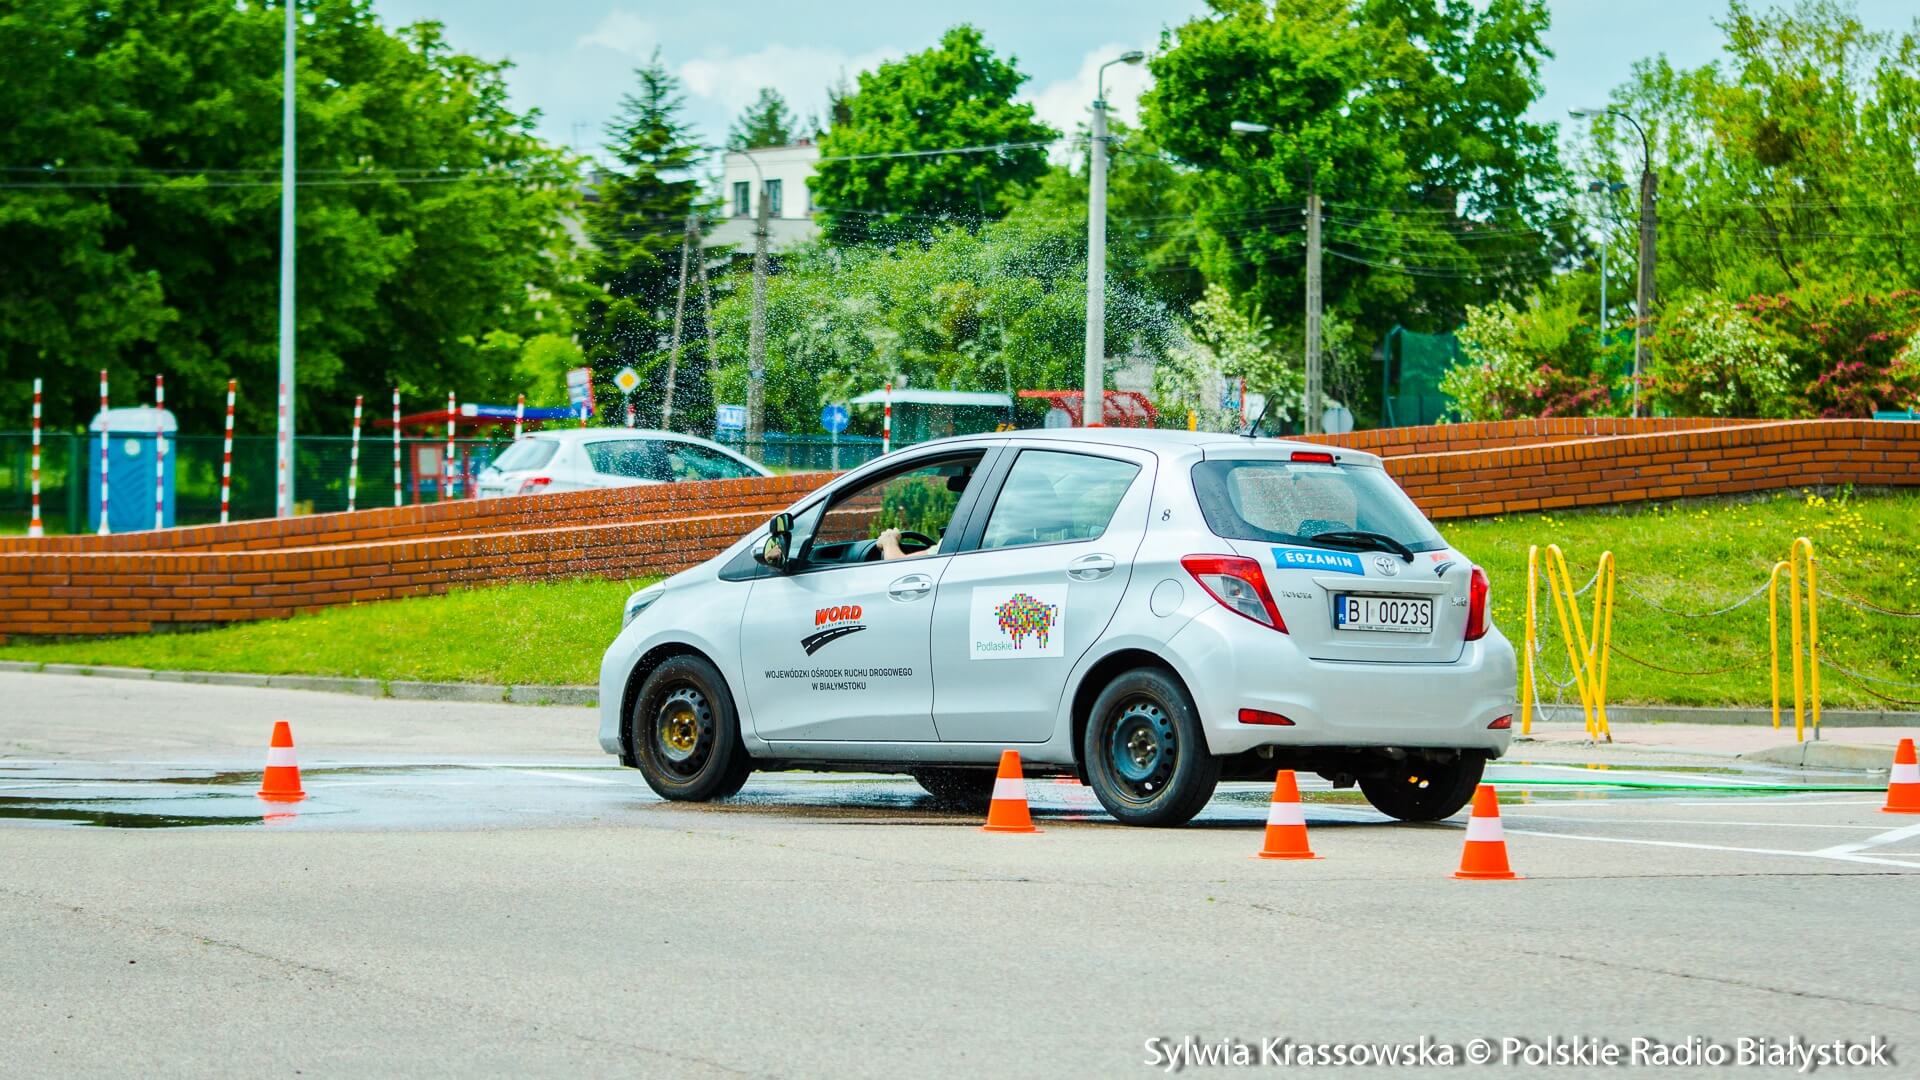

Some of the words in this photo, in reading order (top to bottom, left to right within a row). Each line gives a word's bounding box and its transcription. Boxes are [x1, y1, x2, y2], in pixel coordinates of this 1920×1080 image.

[1161, 509, 1171, 521] 8
[1285, 552, 1353, 567] EGZAMIN
[1281, 591, 1313, 599] TOYOTA
[815, 605, 862, 625] WORD
[1379, 601, 1429, 625] 0023S
[976, 641, 1013, 651] Podlaskie
[765, 667, 810, 678] WOJEWÓDZKI
[811, 667, 843, 678] OŚRODEK
[844, 668, 868, 677] RUCHU
[869, 667, 913, 677] DROGOWEGO
[811, 682, 819, 690] W
[819, 681, 867, 691] BIAŁYMSTOKU
